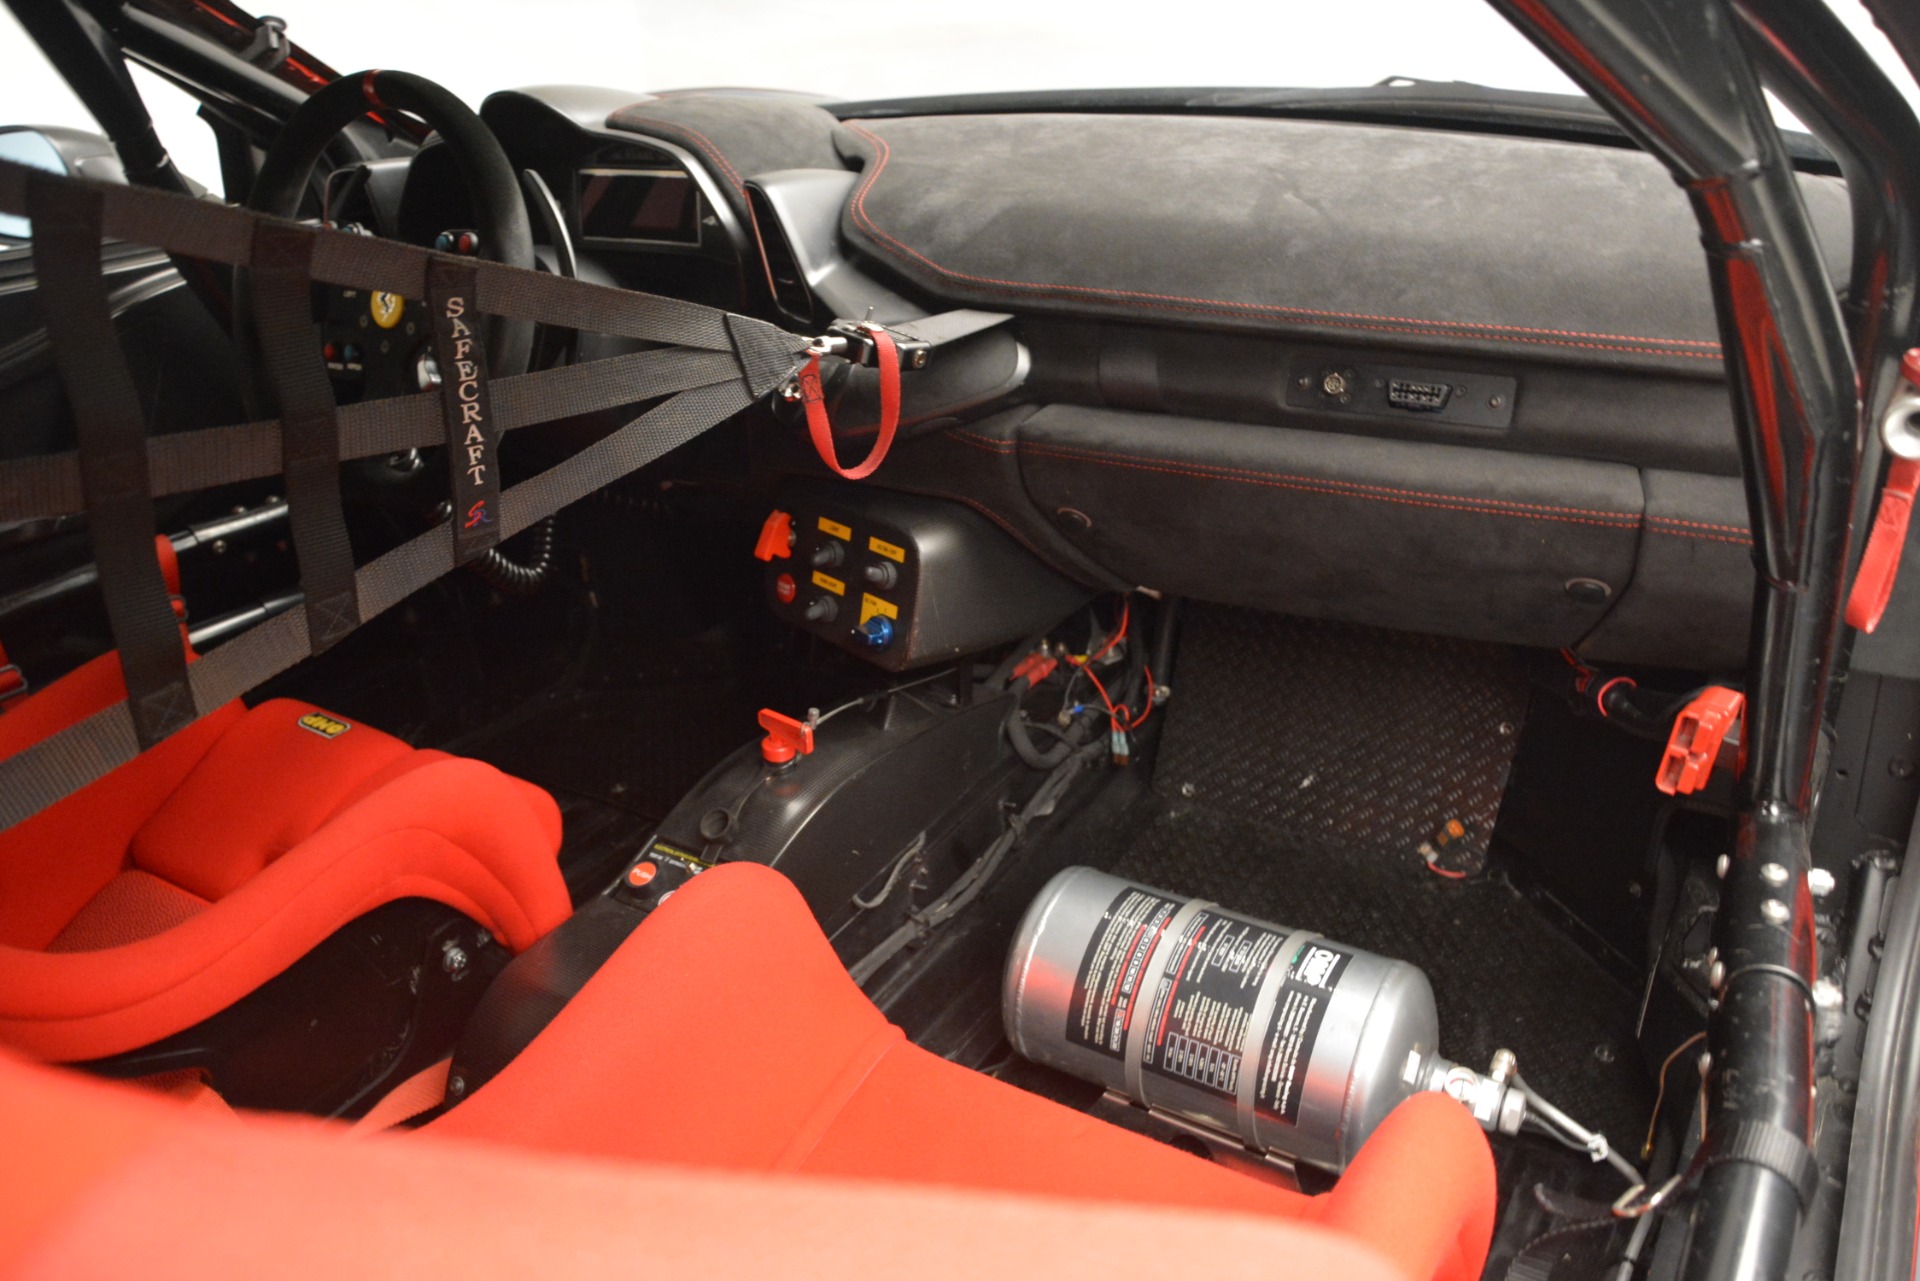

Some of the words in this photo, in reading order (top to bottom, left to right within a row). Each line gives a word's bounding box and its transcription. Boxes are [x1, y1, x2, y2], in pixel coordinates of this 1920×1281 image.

[446, 297, 486, 485] SAFECRAFT
[302, 715, 345, 735] OMP
[1303, 949, 1334, 987] OMP
